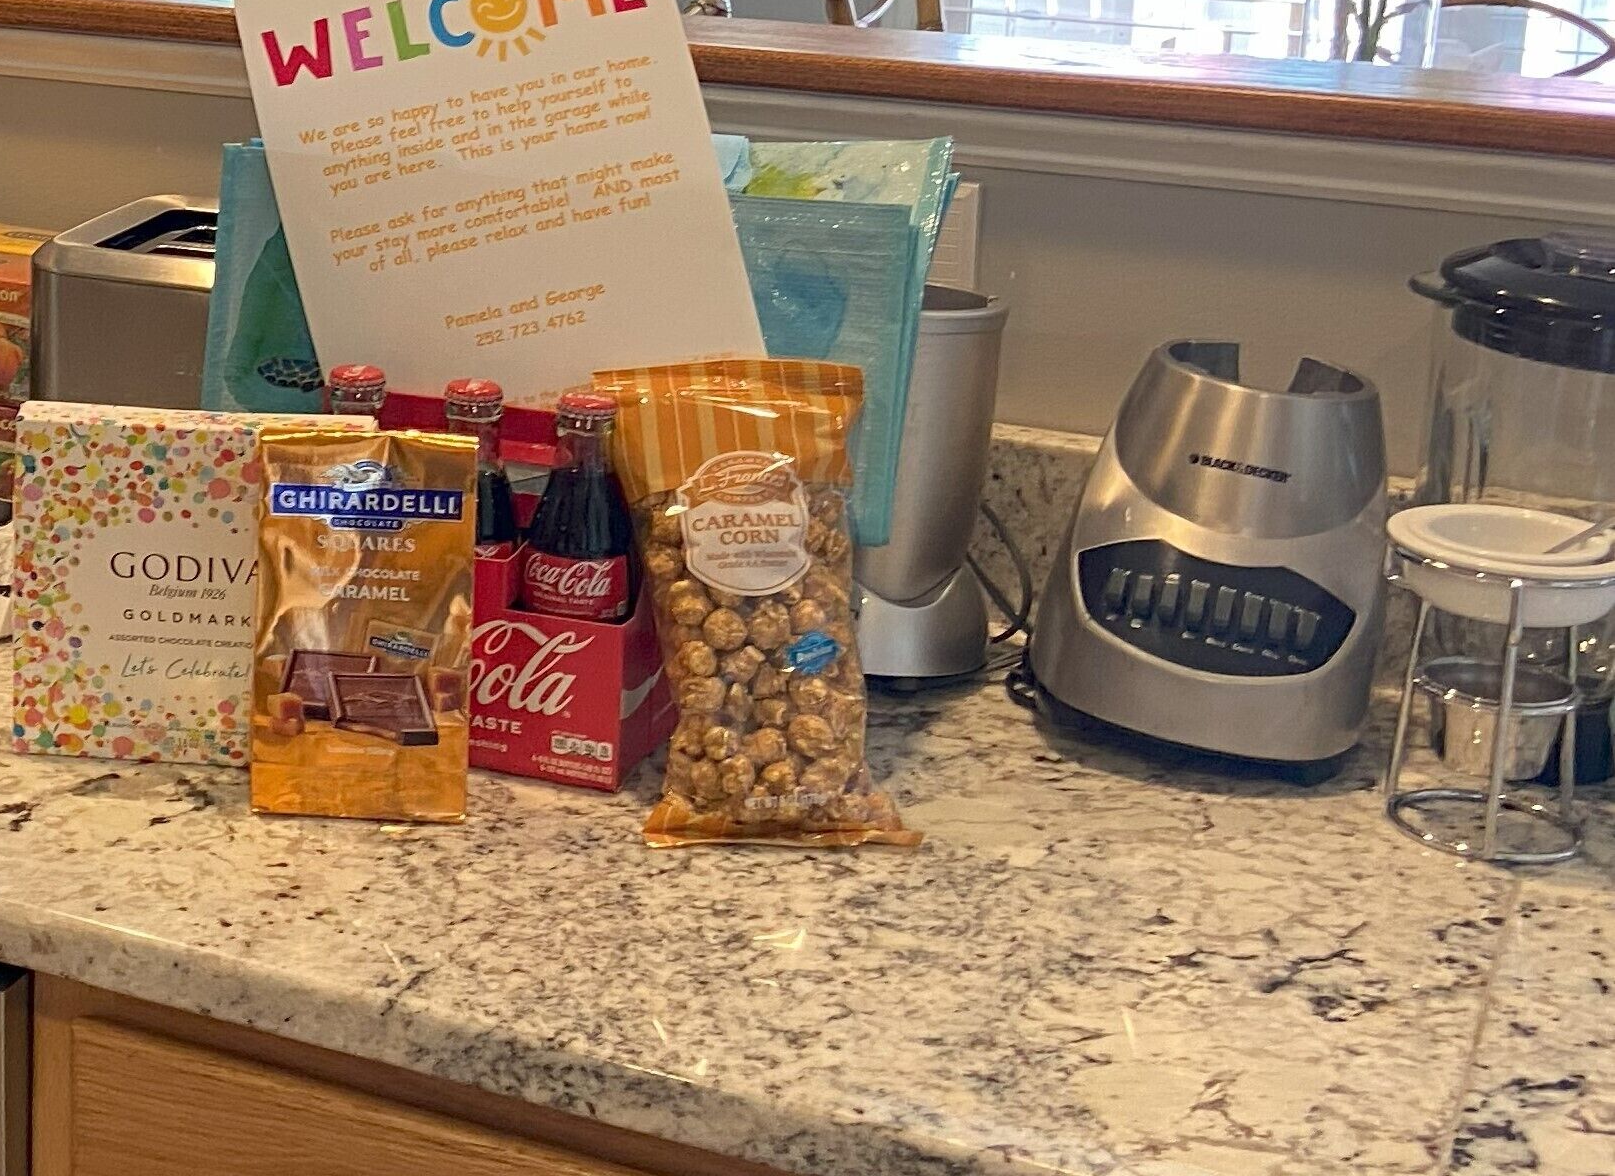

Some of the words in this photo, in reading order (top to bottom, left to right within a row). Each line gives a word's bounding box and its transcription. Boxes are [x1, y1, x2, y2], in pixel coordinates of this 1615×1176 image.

[298, 129, 327, 145] We
[333, 121, 360, 137] are
[367, 116, 384, 129] so
[391, 103, 438, 122] happy
[446, 96, 464, 109] to
[470, 87, 508, 103] have
[516, 78, 545, 96] you
[551, 72, 566, 86] in
[573, 66, 600, 81] our
[330, 134, 382, 155] Please
[390, 121, 421, 141] feel
[429, 115, 466, 133] free
[472, 109, 489, 121] to
[496, 98, 531, 116] help
[538, 78, 607, 110] yourself
[614, 76, 632, 89] to
[322, 151, 391, 176] anything
[396, 137, 444, 158] inside
[451, 127, 480, 145] and
[488, 123, 502, 136] in
[509, 116, 537, 131] the
[544, 101, 601, 127] garage
[608, 90, 651, 109] while
[329, 178, 358, 198] you
[364, 170, 391, 185] are
[456, 142, 494, 160] This
[500, 138, 514, 151] is
[520, 129, 558, 151] your
[565, 118, 609, 136] home
[330, 223, 381, 243] Please
[387, 212, 415, 230] ask
[421, 205, 447, 222] for
[455, 187, 526, 213] anything
[531, 175, 568, 194] that
[575, 162, 623, 185] might
[630, 152, 675, 171] make
[332, 244, 367, 267] your
[375, 234, 410, 252] stay
[417, 223, 458, 241] more
[593, 179, 633, 200] AND
[640, 169, 680, 188] most
[370, 254, 386, 272] of
[426, 236, 478, 262] please
[485, 224, 527, 243] relax
[536, 212, 566, 231] and
[571, 205, 612, 222] have
[444, 306, 503, 329] Pamela
[509, 295, 539, 315] and
[545, 283, 606, 306] George
[278, 490, 459, 514] GHIRARDELLI
[334, 519, 400, 529] CHOCOLATE
[692, 513, 800, 532] CARAMEL
[720, 530, 780, 545] CORN
[149, 584, 197, 599] Belgium
[528, 552, 616, 598] Coca-Cola
[123, 608, 252, 627] GOLDMARK
[158, 637, 212, 648] CHOCOLATE
[471, 715, 522, 734] ASTE
